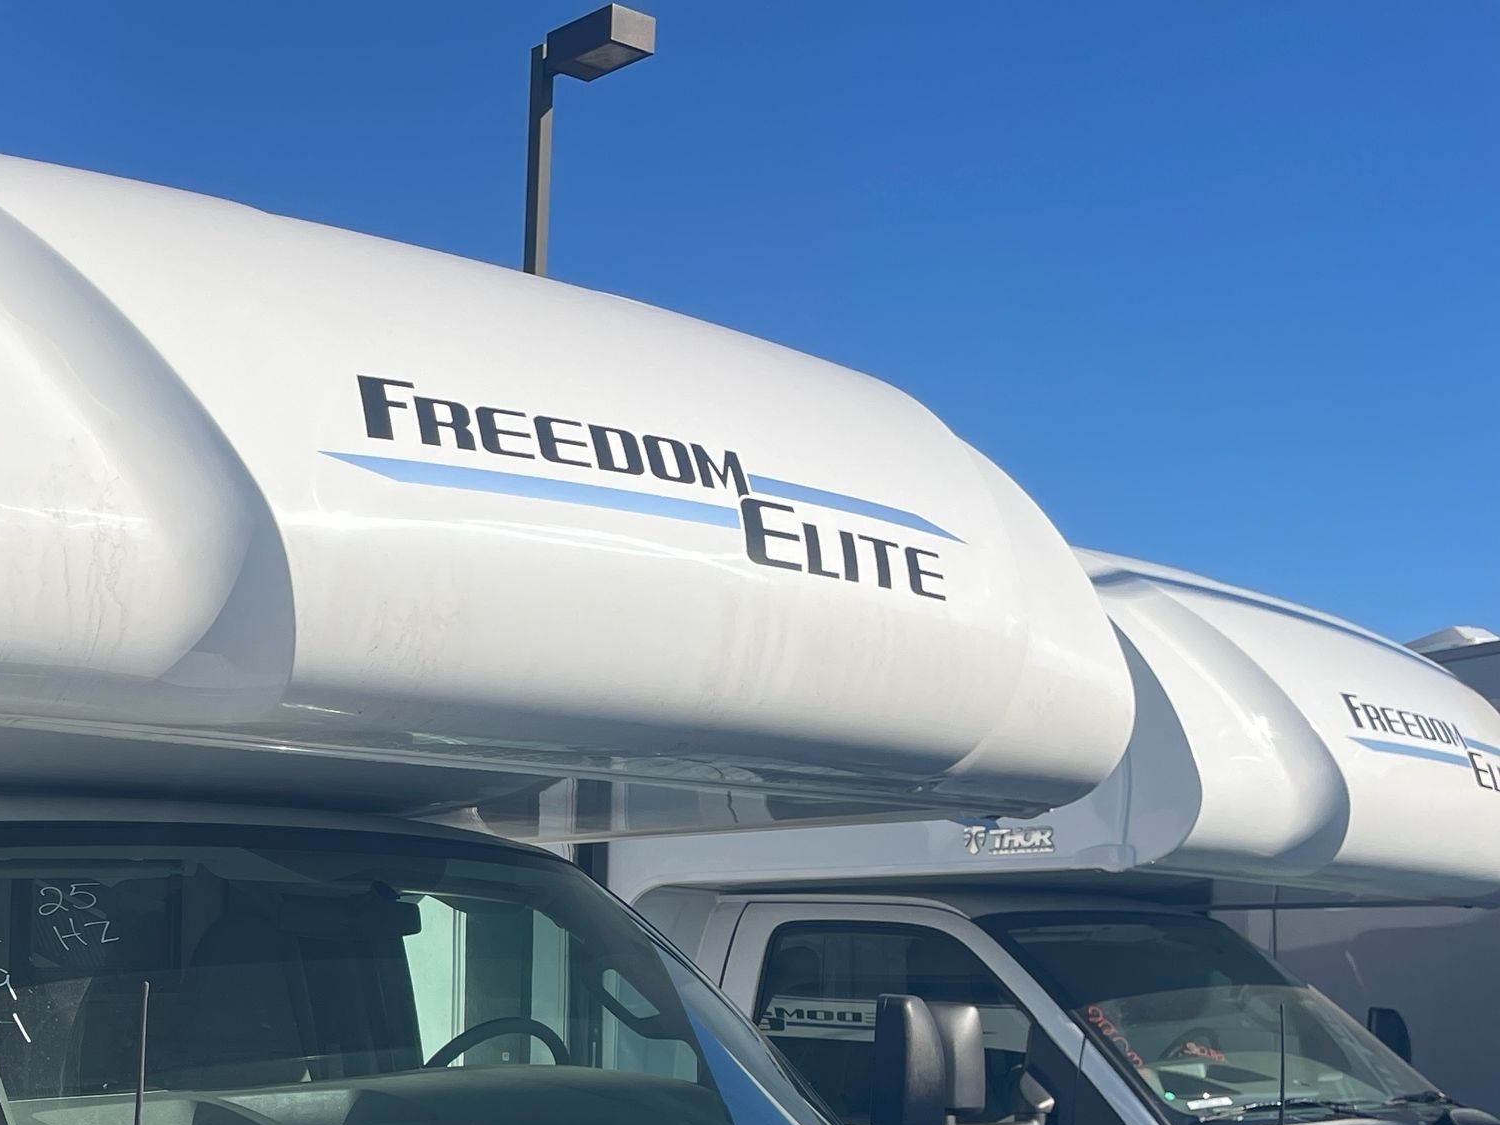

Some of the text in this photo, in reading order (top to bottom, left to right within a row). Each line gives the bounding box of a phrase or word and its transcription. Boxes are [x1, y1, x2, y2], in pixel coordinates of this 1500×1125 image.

[356, 374, 751, 497] FREEDOM
[741, 496, 947, 602] ELITE
[1340, 692, 1468, 750] FREEDOM
[1467, 751, 1500, 793] EL
[988, 827, 1054, 849] THOR
[38, 882, 101, 916] 25
